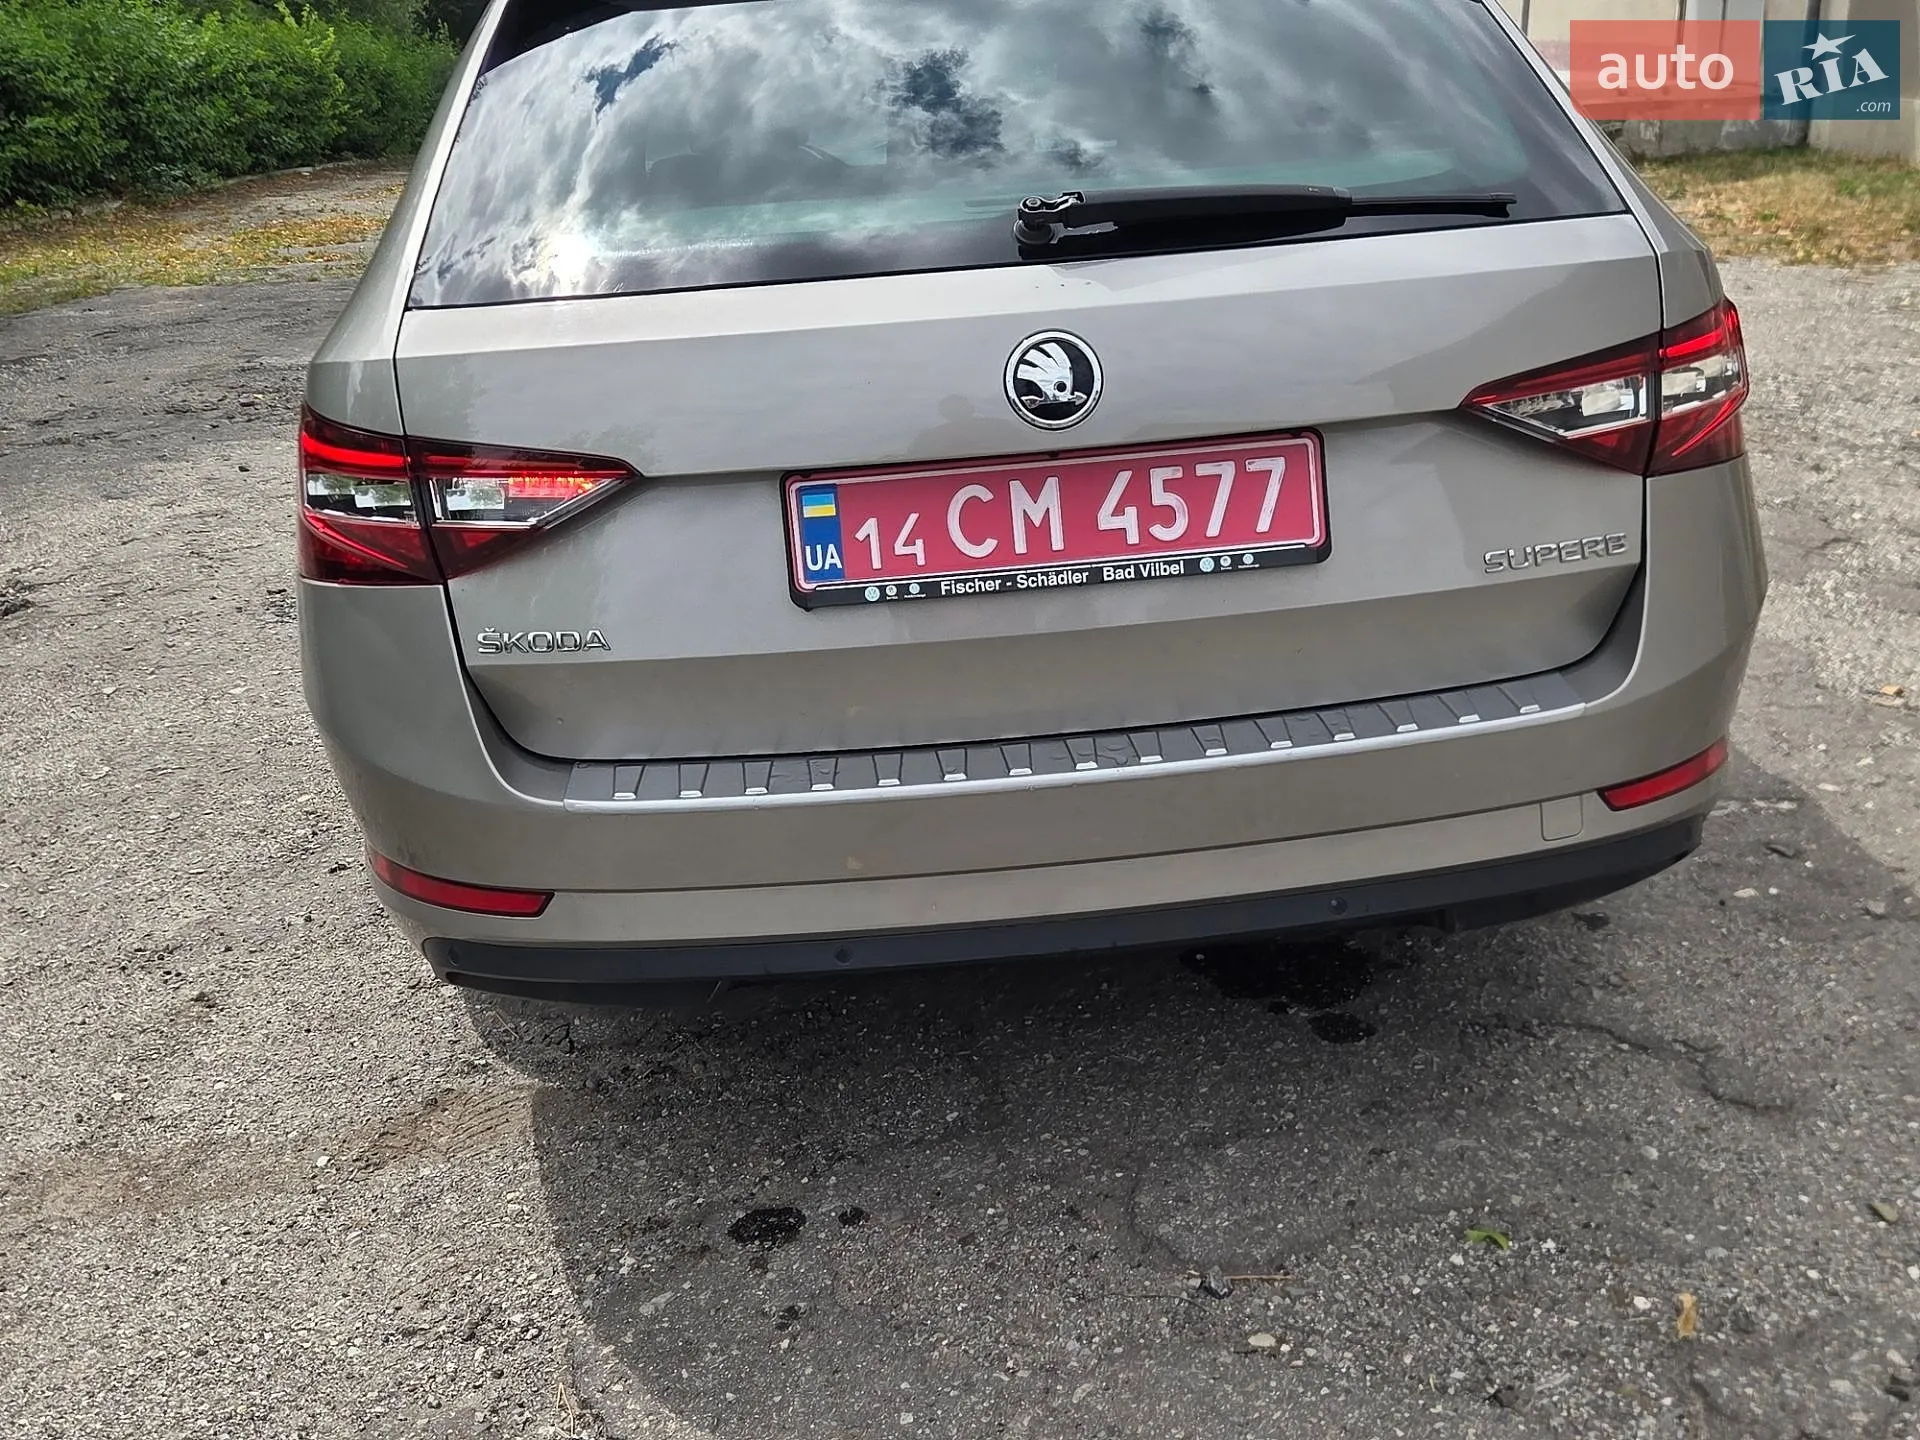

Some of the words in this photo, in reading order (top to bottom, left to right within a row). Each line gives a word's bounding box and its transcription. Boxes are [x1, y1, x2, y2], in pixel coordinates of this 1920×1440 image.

[854, 511, 927, 570] 14
[946, 476, 1065, 559] CM
[1096, 456, 1287, 545] 4577
[804, 543, 843, 571] UA
[1483, 531, 1629, 574] SUPERB
[940, 578, 1002, 596] Fischer
[1016, 570, 1090, 589] Schädler
[1102, 564, 1136, 582] Bad
[1139, 560, 1185, 578] Vilbel
[476, 626, 612, 654] ŠKODA
